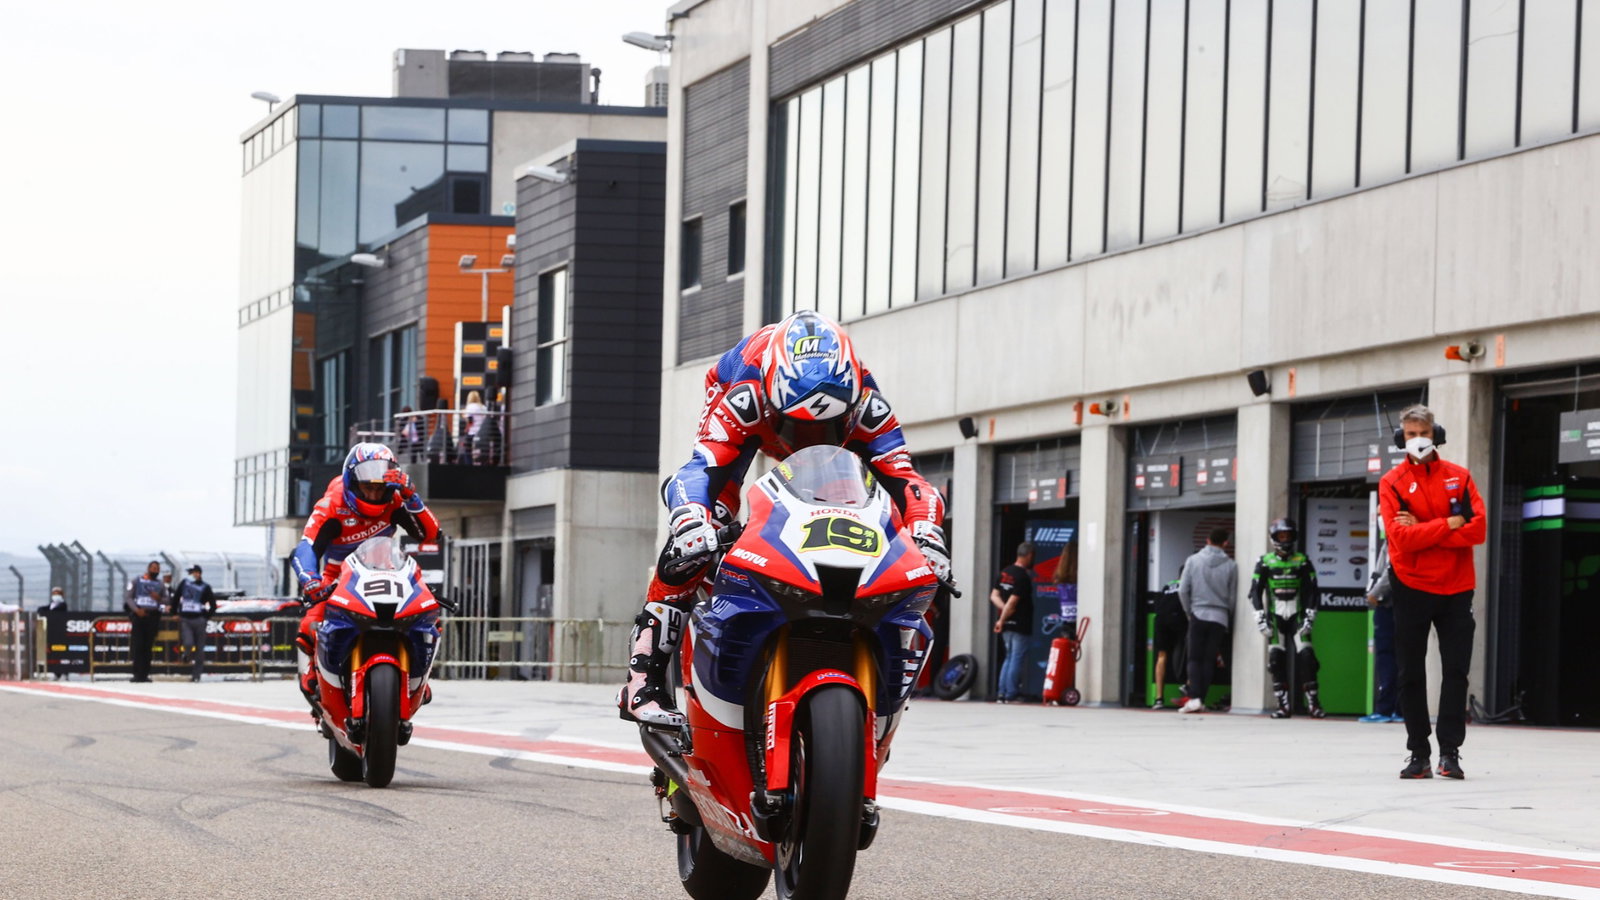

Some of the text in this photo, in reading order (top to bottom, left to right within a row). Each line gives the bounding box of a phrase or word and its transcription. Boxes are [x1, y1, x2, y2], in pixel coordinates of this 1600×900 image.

[810, 508, 861, 520] HONDA
[341, 520, 388, 542] HONDA
[801, 516, 881, 556] 19
[731, 548, 769, 567] MOTUL
[906, 565, 933, 581] MOTUL
[364, 579, 404, 598] 91
[666, 609, 682, 647] SIDI
